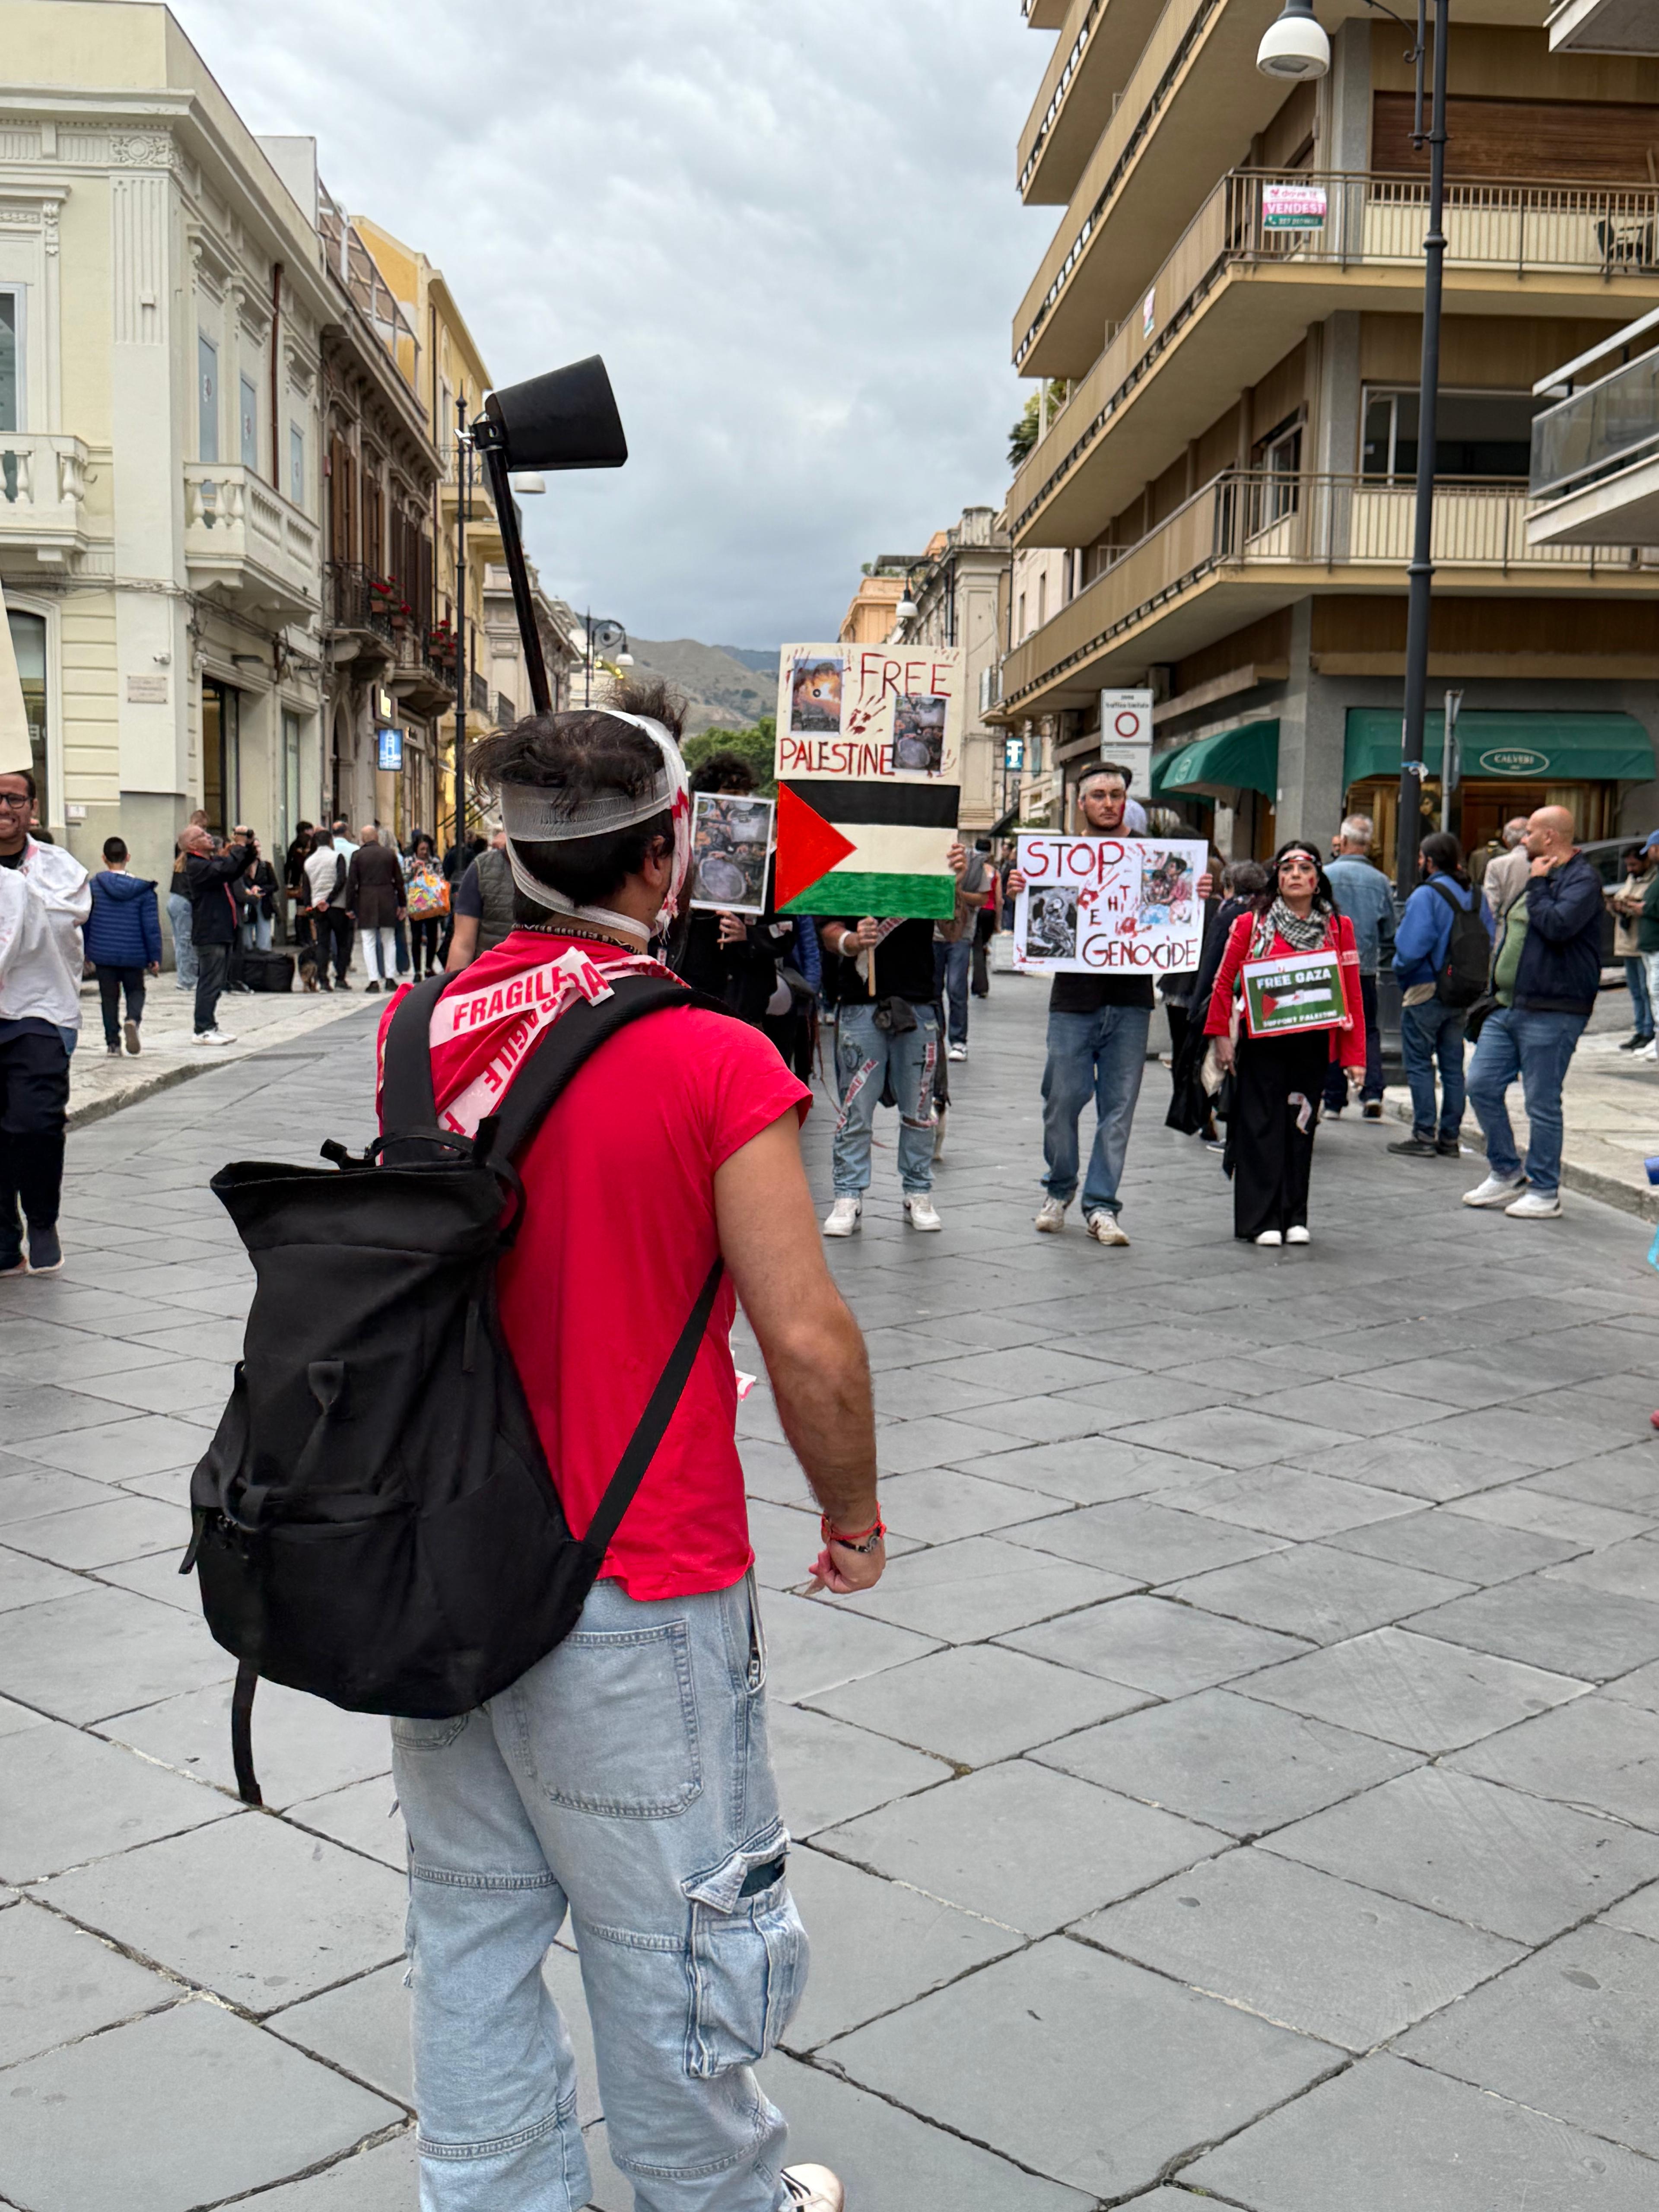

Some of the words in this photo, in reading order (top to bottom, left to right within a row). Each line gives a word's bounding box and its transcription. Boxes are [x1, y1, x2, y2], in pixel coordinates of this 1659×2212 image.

[1267, 203, 1323, 214] VENDESI
[858, 652, 953, 702] FREE
[780, 737, 895, 777] PALESTINE
[1023, 841, 1124, 884] STOP
[1082, 934, 1198, 969] GENOCIDE
[1256, 974, 1291, 989] FREE
[1295, 968, 1332, 983] GAZA
